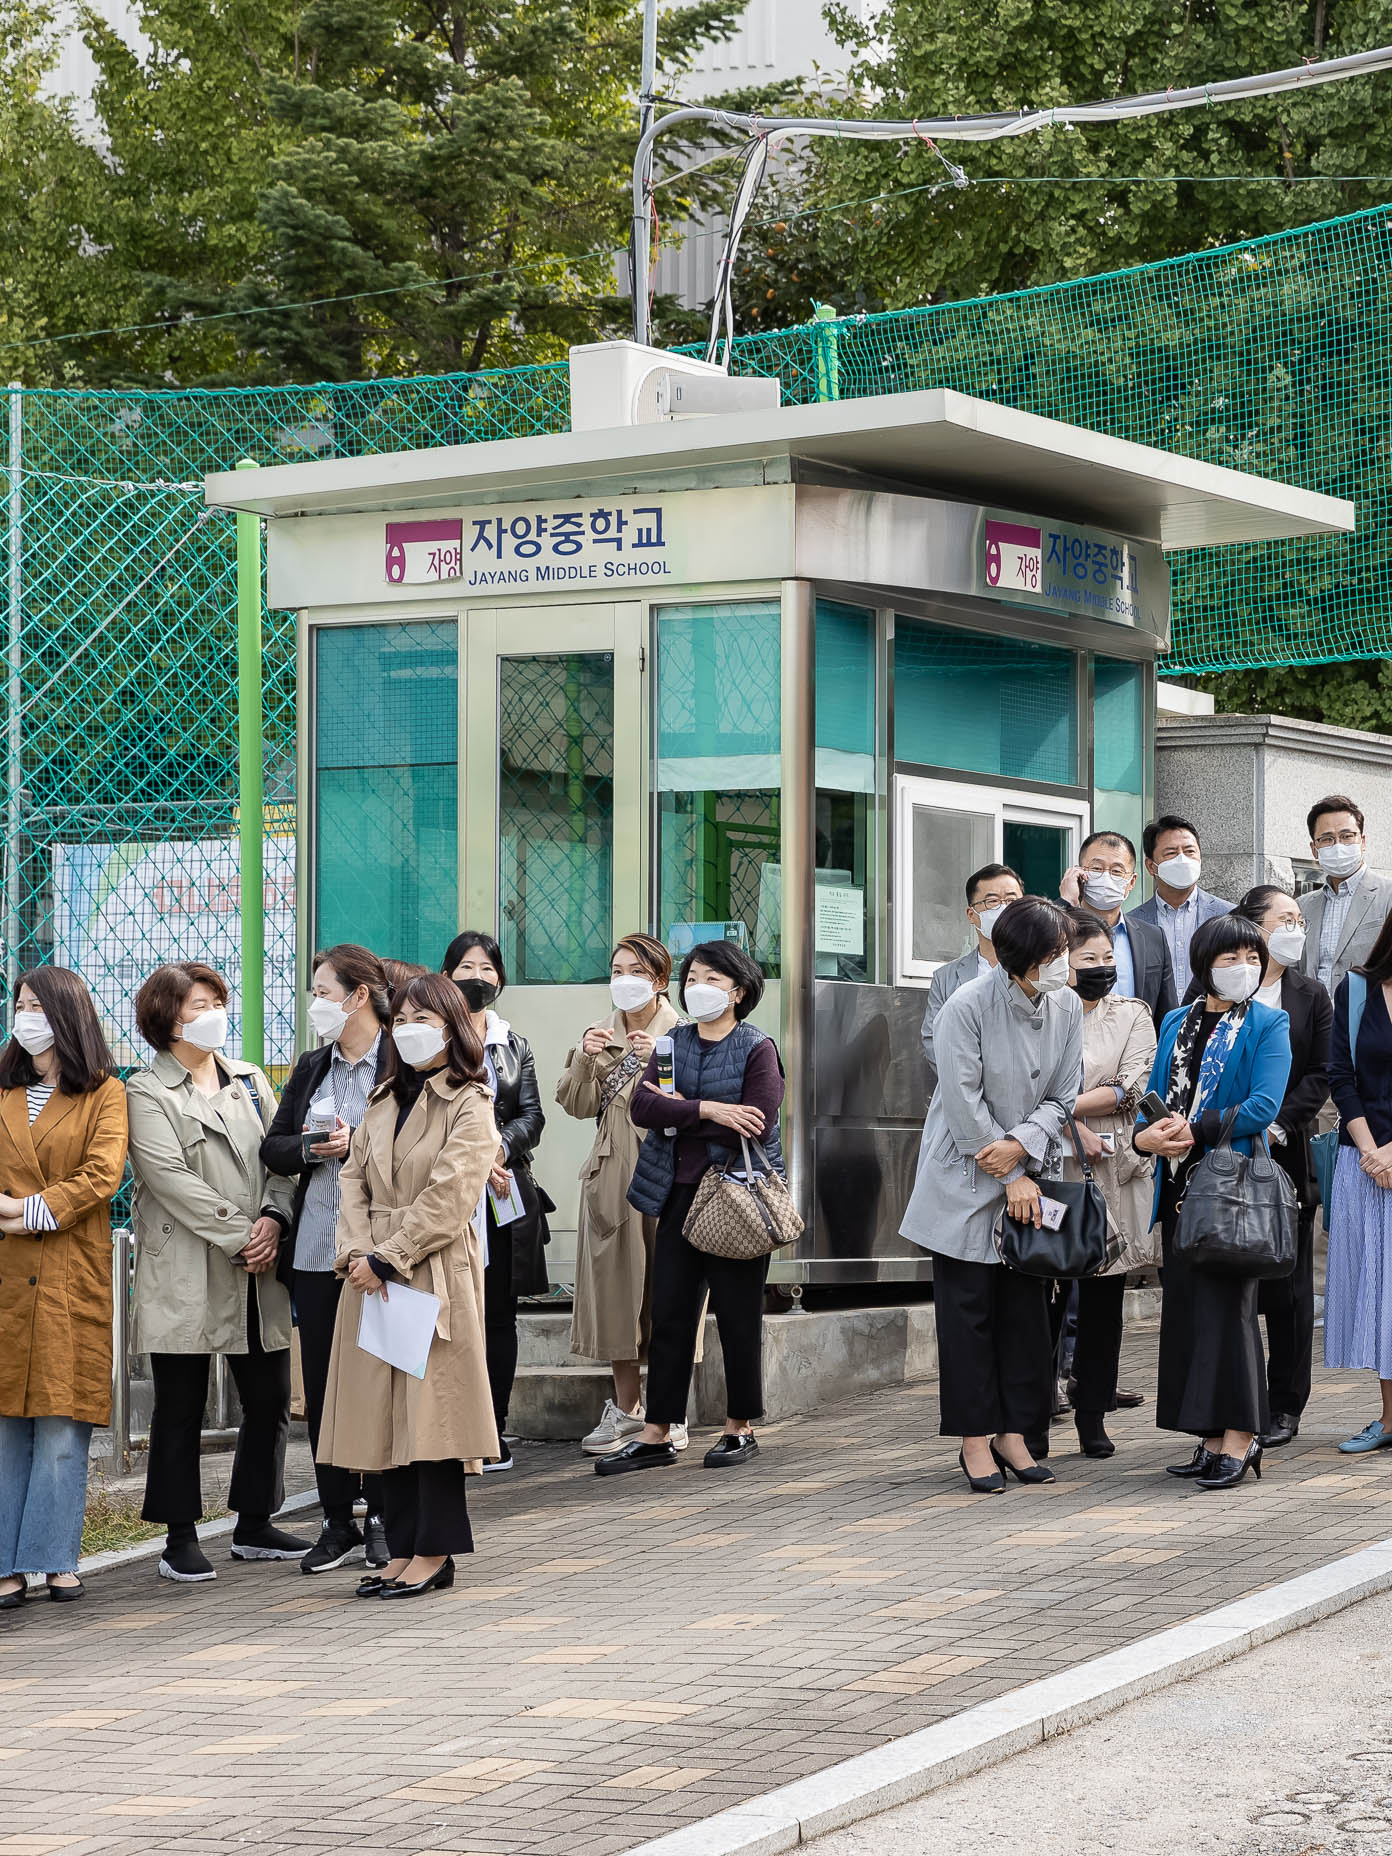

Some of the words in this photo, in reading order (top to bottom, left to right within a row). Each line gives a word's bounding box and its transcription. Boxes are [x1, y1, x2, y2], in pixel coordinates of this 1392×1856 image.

[470, 507, 666, 560] 자양중학교
[427, 547, 460, 580] 자양
[468, 569, 529, 586] JAYANG
[535, 565, 598, 581] MIDDLE
[603, 561, 671, 577] SCHOOL
[1016, 554, 1040, 589] 자양
[1047, 533, 1139, 595] 자양중학교
[1045, 584, 1081, 604] JAYANG
[1084, 589, 1113, 611] MIDDLE
[1115, 597, 1141, 620] SCHOOL
